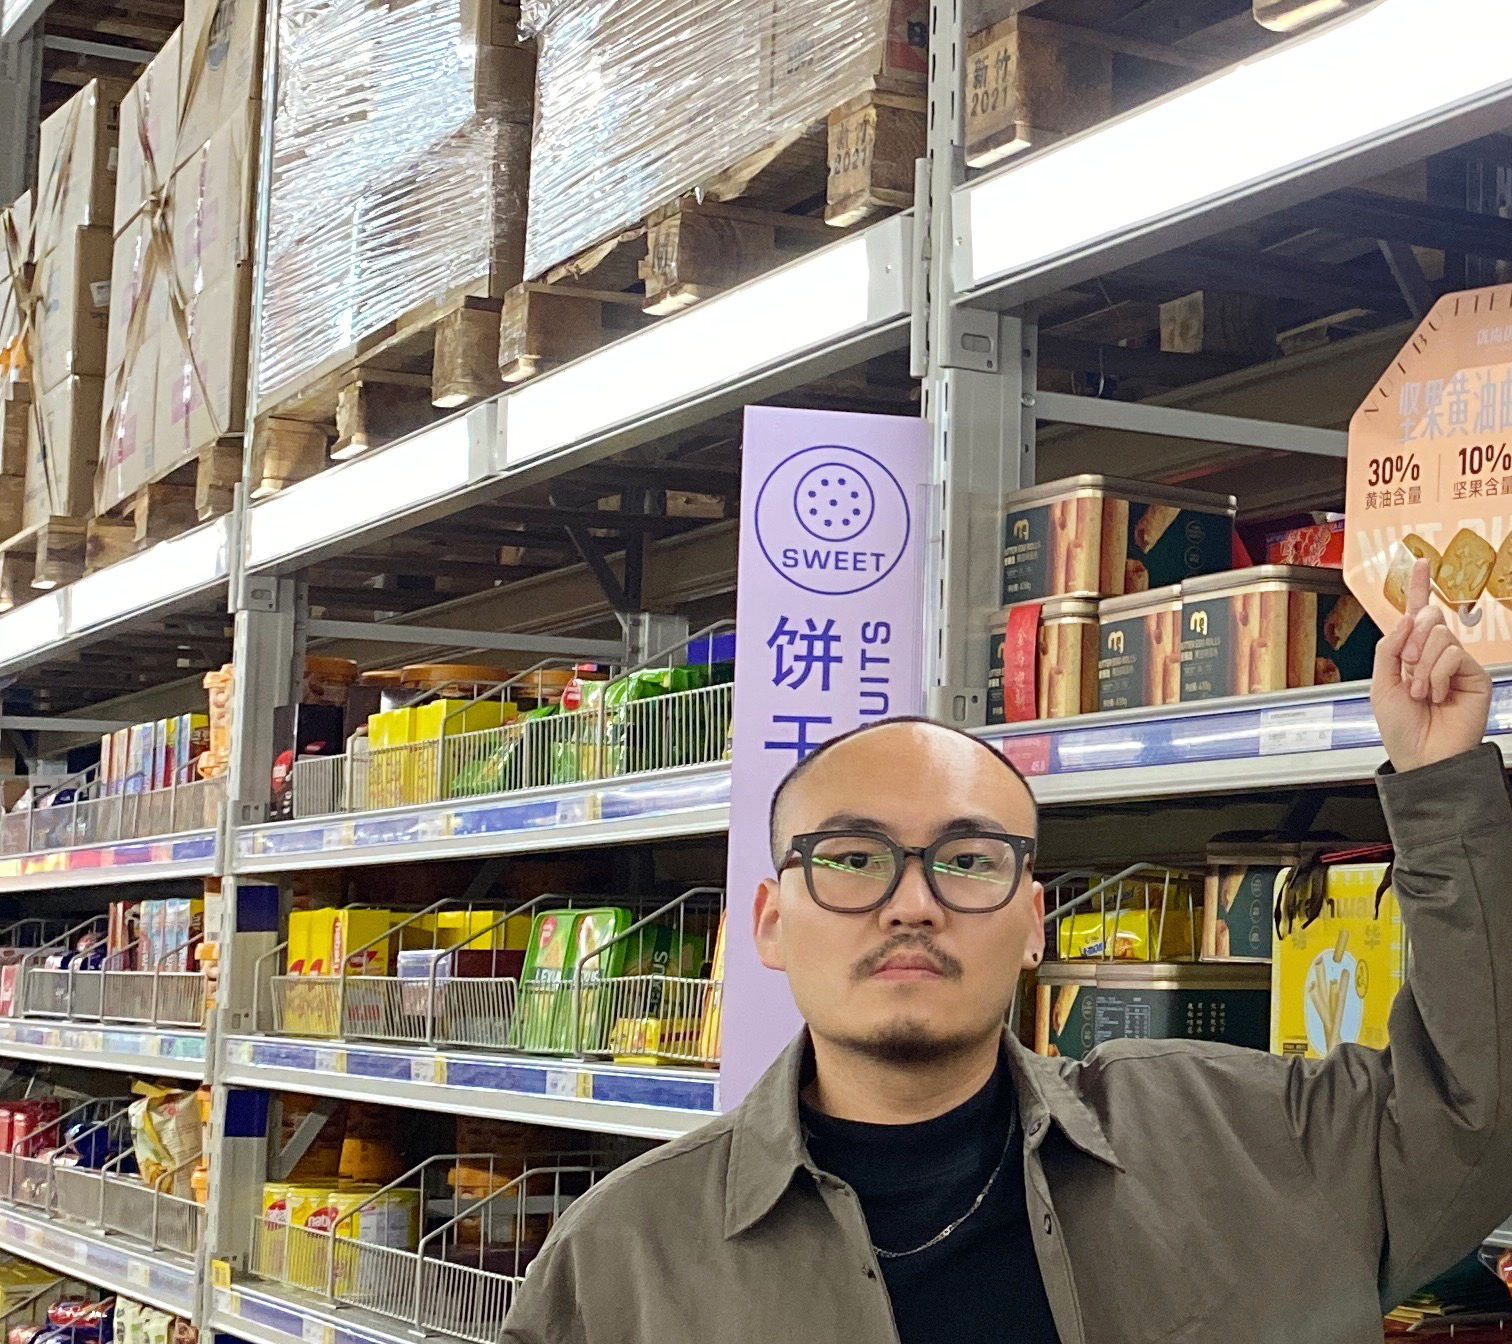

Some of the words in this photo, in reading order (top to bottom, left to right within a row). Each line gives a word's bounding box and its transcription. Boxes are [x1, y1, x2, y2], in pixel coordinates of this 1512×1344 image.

[1368, 453, 1420, 487] 30%
[1458, 443, 1511, 476] 10%
[1365, 485, 1422, 511] 黄油含量
[782, 549, 886, 572] SWEET
[764, 615, 843, 764] 饼干
